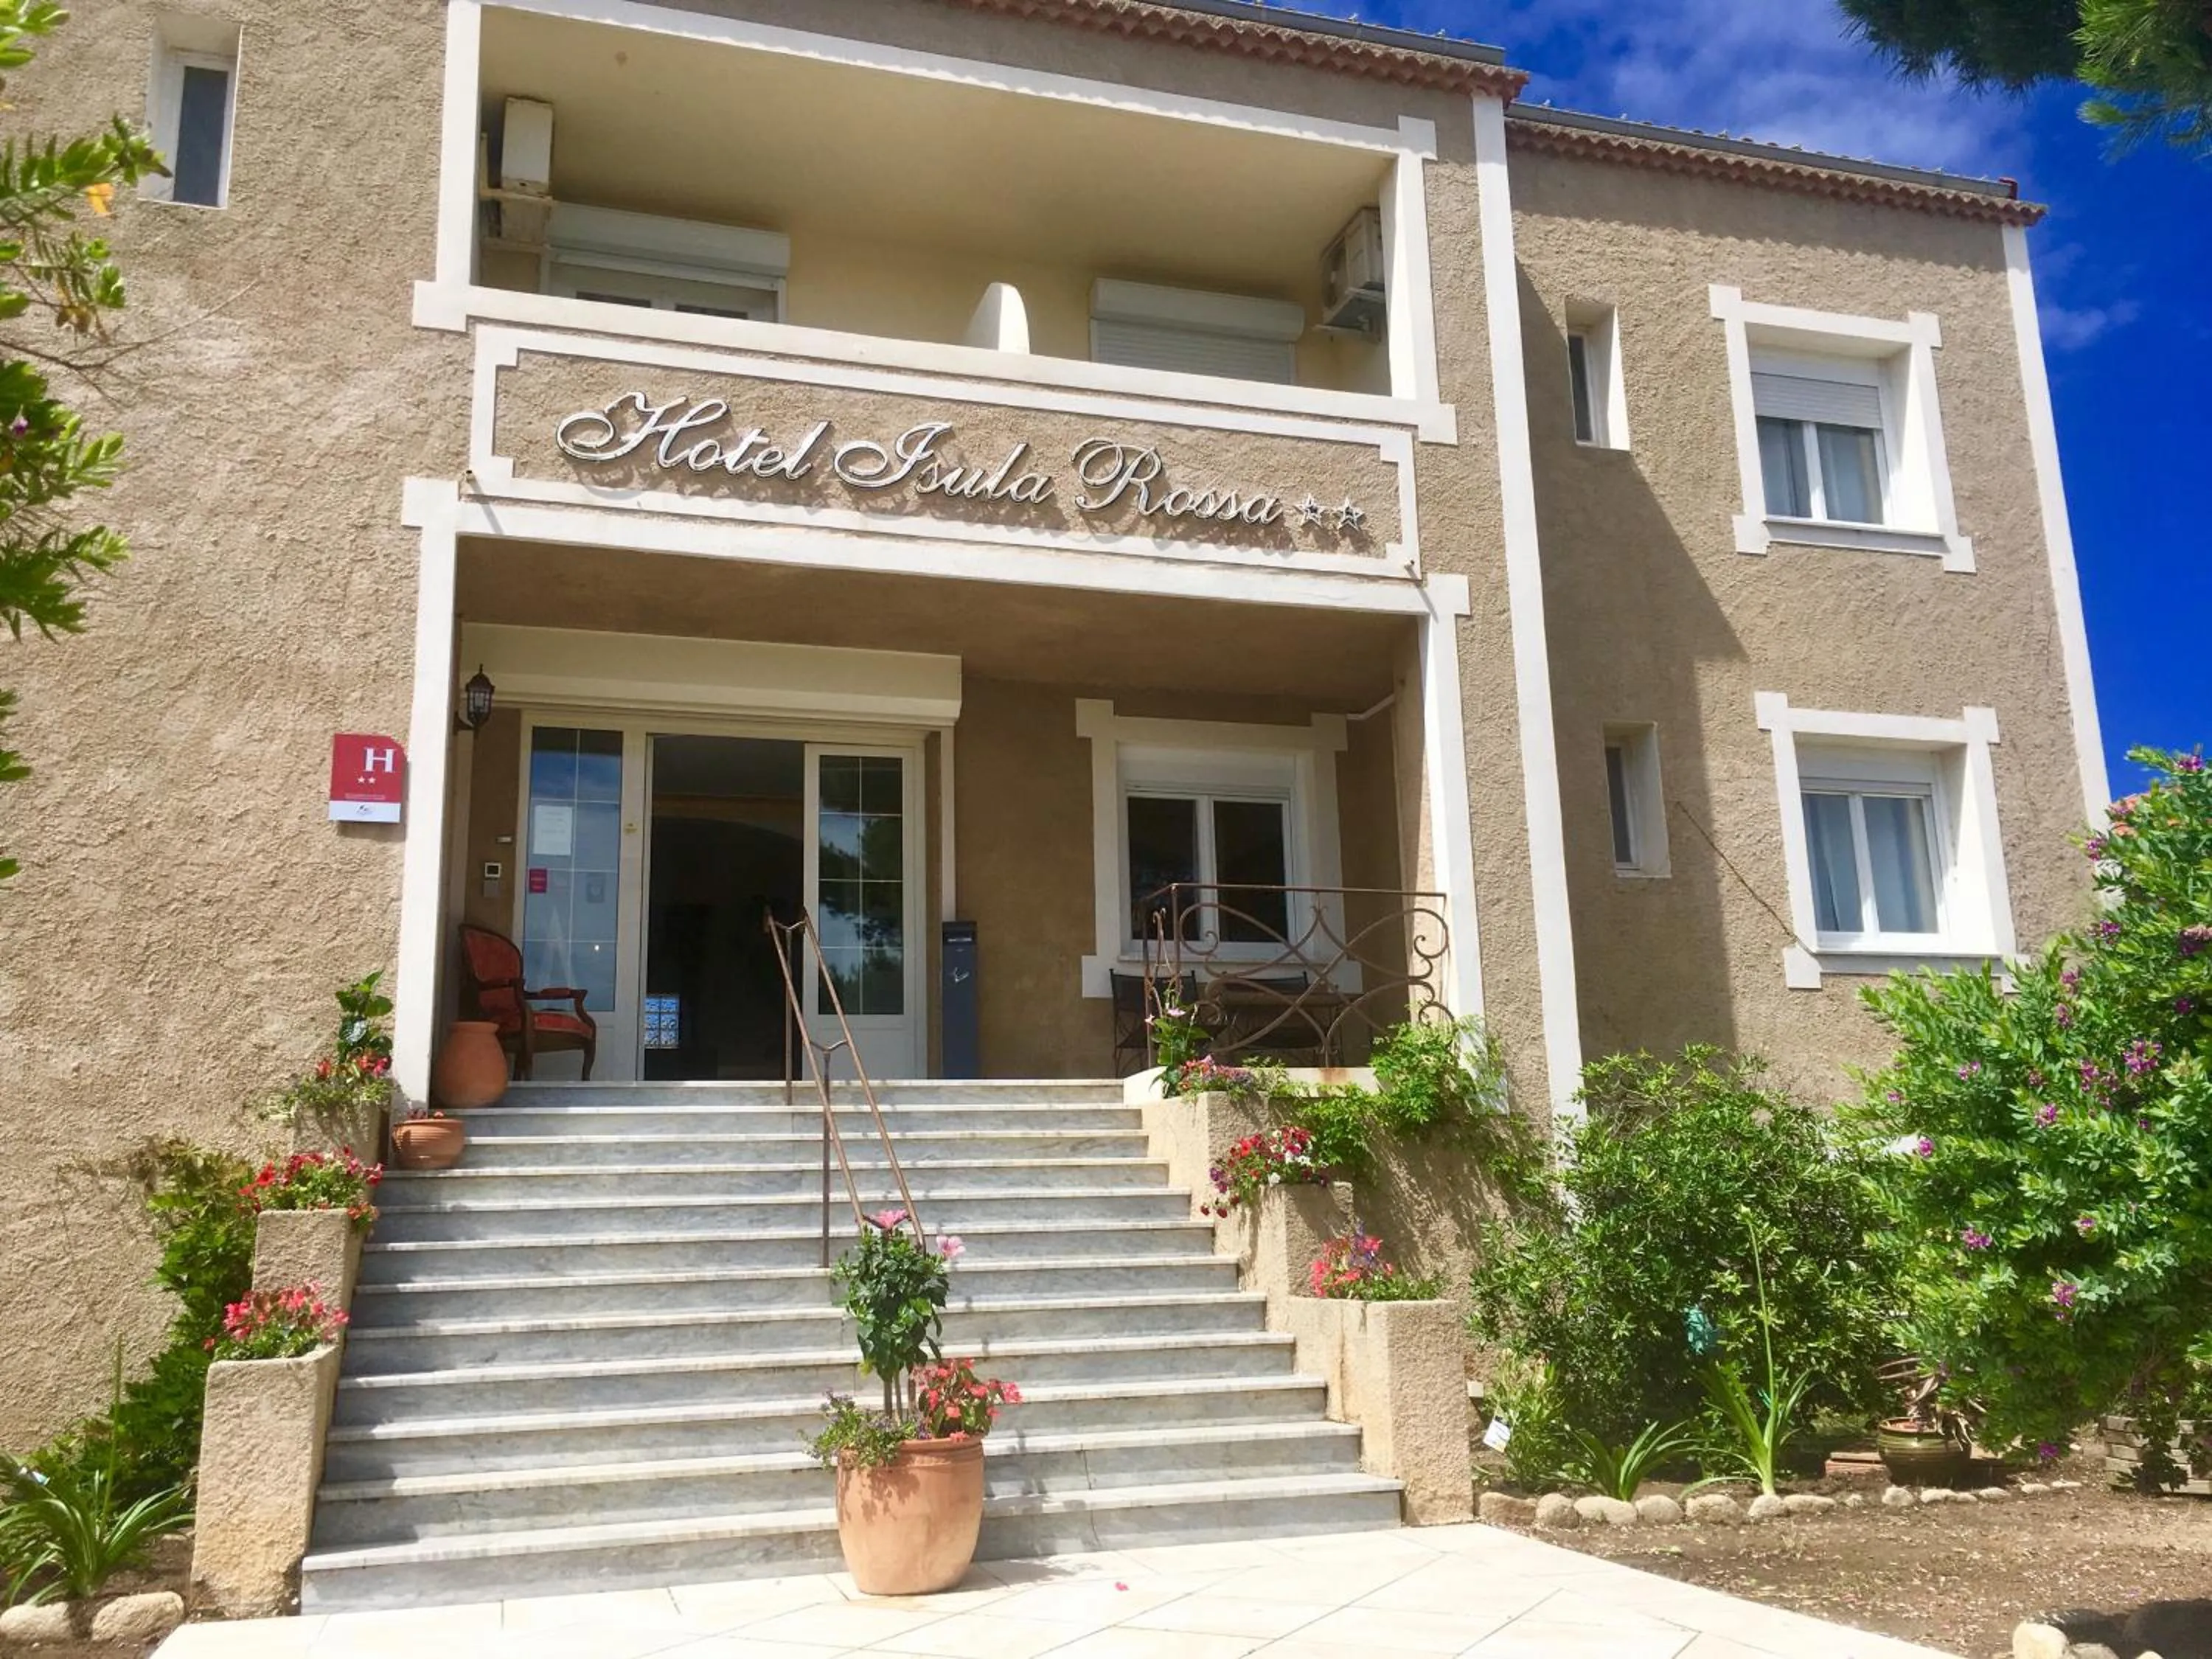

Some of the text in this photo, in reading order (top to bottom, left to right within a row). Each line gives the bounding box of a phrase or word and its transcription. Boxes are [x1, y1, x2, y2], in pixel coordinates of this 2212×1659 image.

[556, 391, 1283, 525] Hotel Isula Rossa
[363, 748, 396, 773] H
